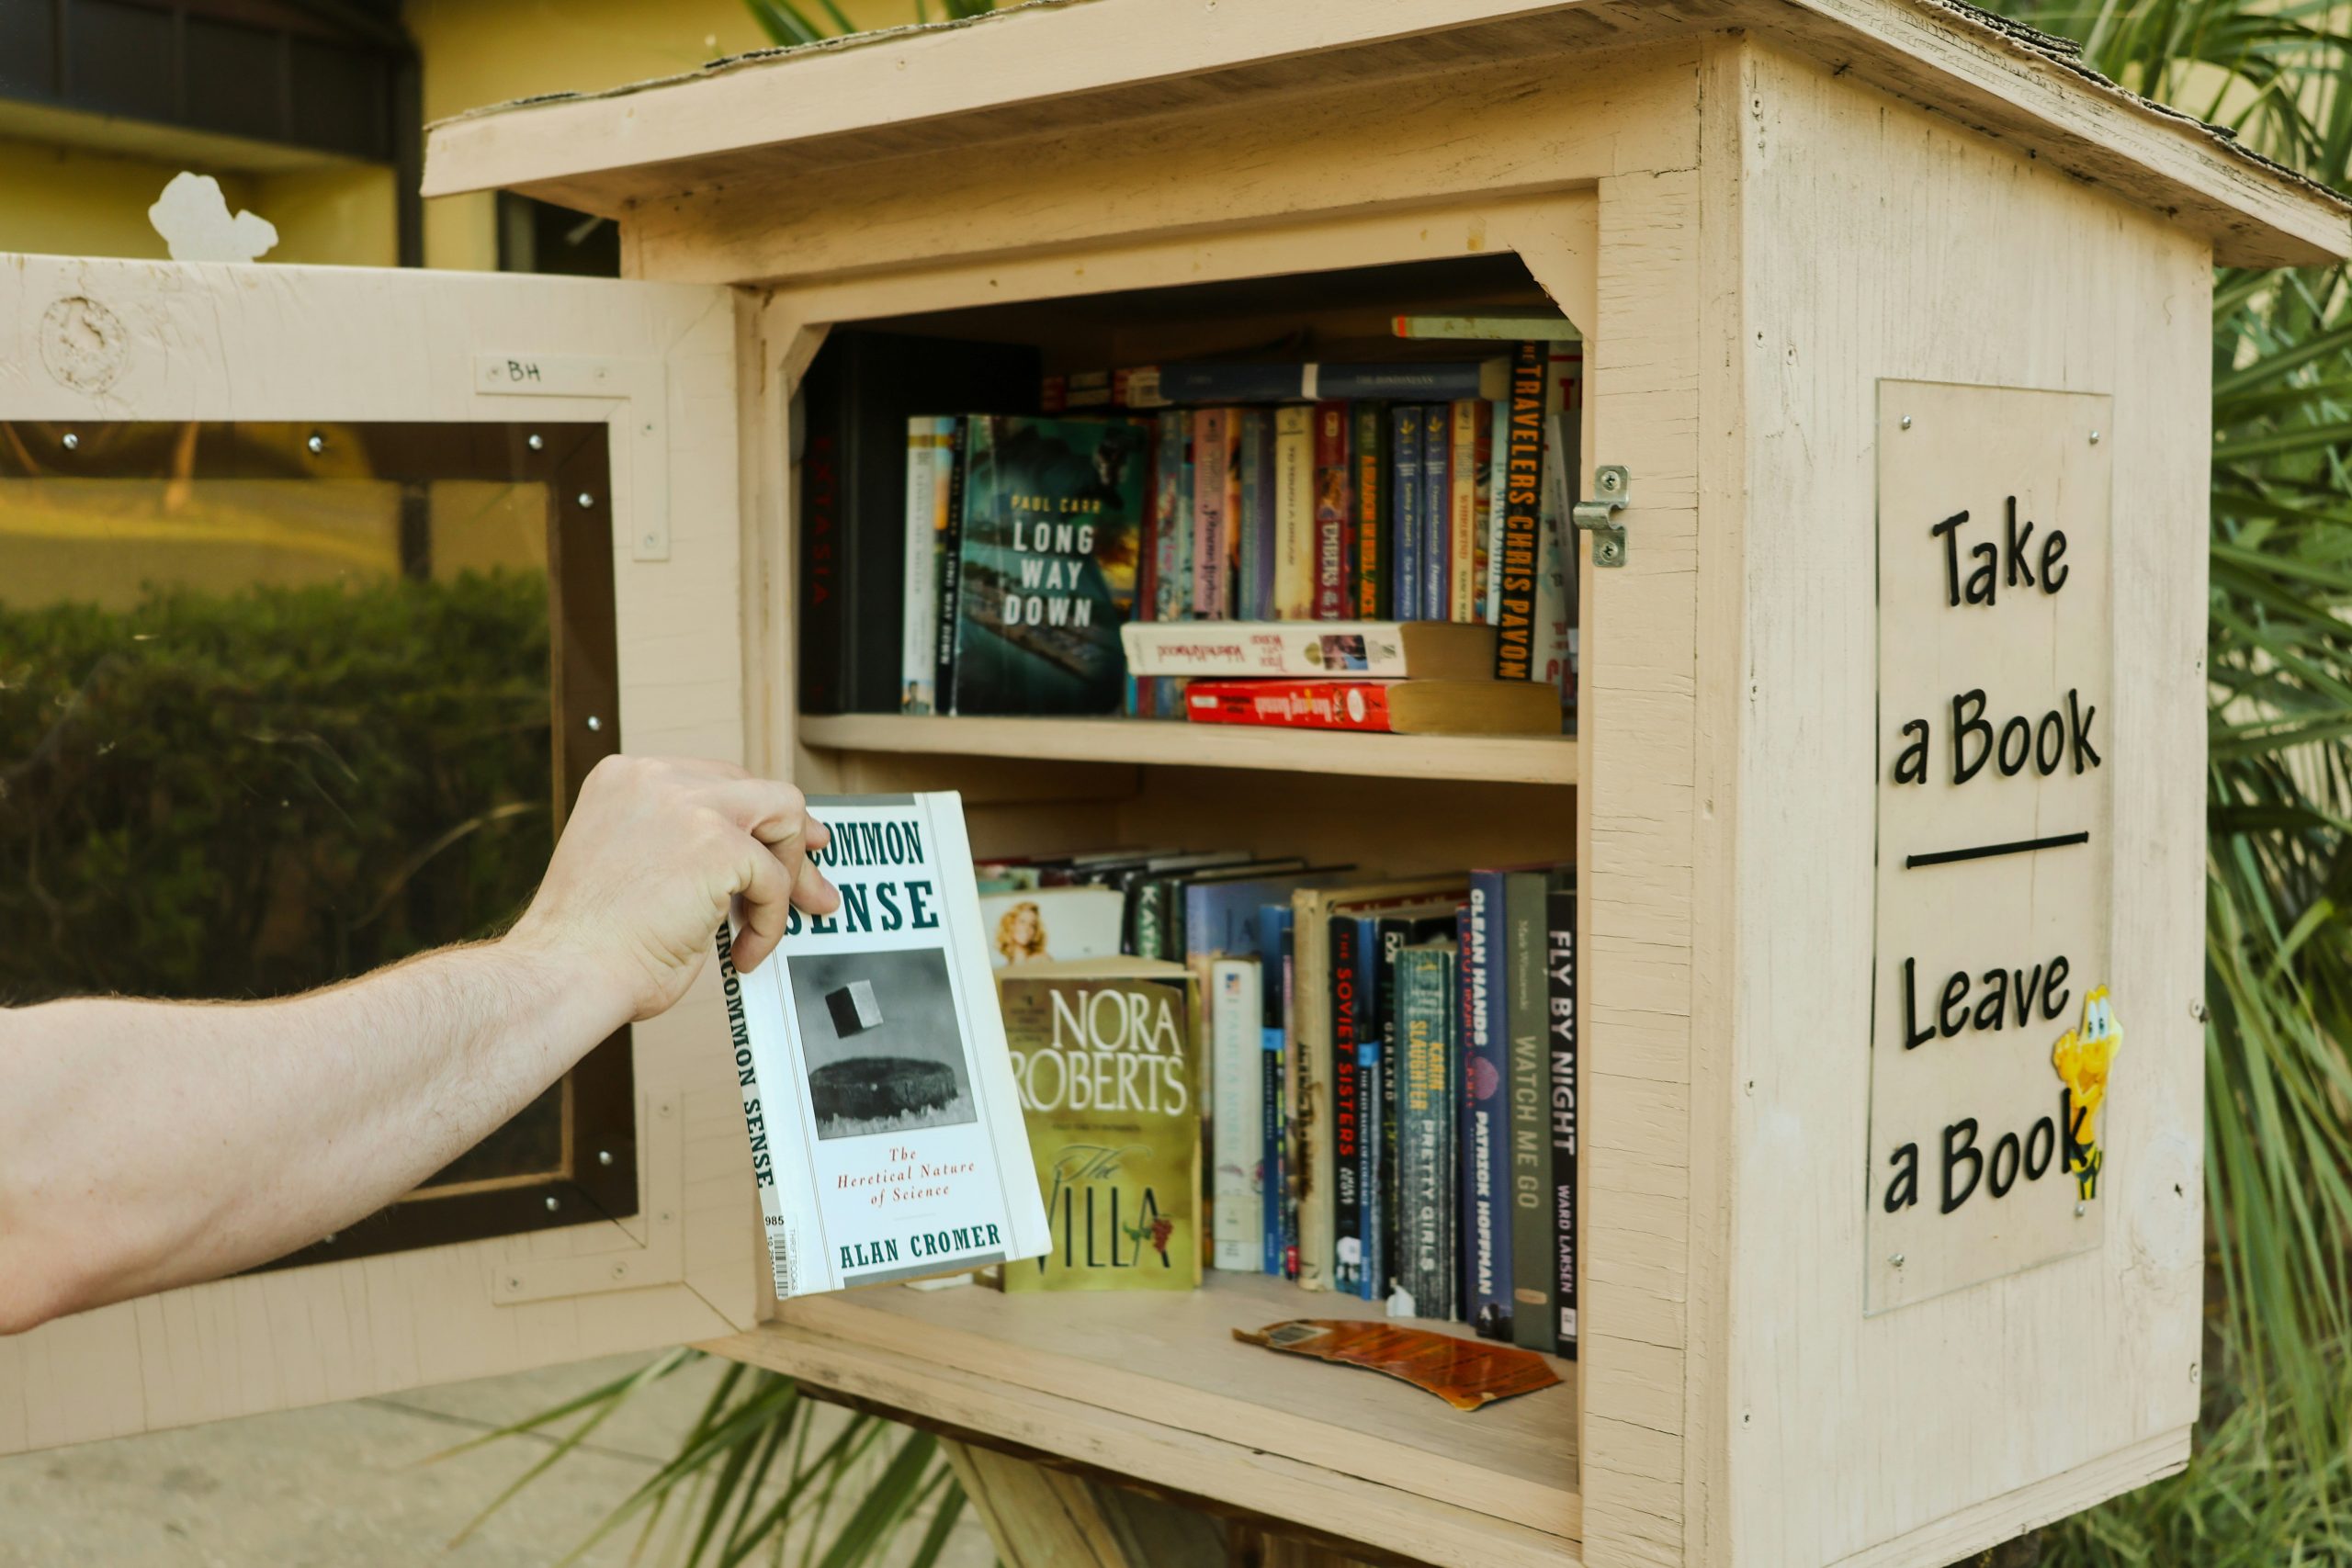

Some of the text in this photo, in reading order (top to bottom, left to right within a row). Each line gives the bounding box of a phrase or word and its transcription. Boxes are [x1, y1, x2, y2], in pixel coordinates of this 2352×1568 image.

[507, 360, 540, 381] BH
[1508, 365, 1542, 505] TRAVELERS
[1012, 495, 1101, 513] PAUL CARR
[1287, 467, 1295, 506] TOUCH
[1012, 521, 1093, 555] LONG
[1322, 522, 1340, 586] EMBERS
[1504, 514, 1534, 592] CHRIS
[1933, 496, 2069, 607] Take
[945, 551, 955, 586] LONG
[1021, 558, 1083, 590] WAY
[944, 592, 953, 619] WAY
[1003, 595, 1091, 626] DOWN
[940, 625, 952, 664] DOWN
[1498, 600, 1530, 679] PAVON
[1894, 687, 2101, 785] a Book
[1518, 919, 1529, 948] Mark
[1549, 930, 1572, 986] FLY
[1049, 988, 1183, 1056] NORA
[1550, 998, 1573, 1041] BY
[1904, 954, 2069, 1050] Leave
[717, 919, 775, 1190] UNCOMMON SENSE
[1225, 1010, 1240, 1084] PAMELA
[1337, 932, 1354, 1156] THE SOVIET SISTERS
[1385, 1022, 1396, 1101] GARLAND
[1409, 1021, 1428, 1111] SLAUGHTER
[1428, 1043, 1444, 1090] KARIN
[1011, 1048, 1187, 1117] ROBERTS
[1471, 889, 1492, 1294] CLEAN HANDS PATRICK HOFFMAN
[1514, 1036, 1538, 1121] WATCH
[1551, 1051, 1574, 1156] NIGHT
[889, 1147, 917, 1163] The
[1054, 1143, 1153, 1182] The
[1361, 1145, 1368, 1157] OF
[1517, 1130, 1538, 1167] ME
[1884, 1088, 2088, 1214] a Book
[838, 1161, 976, 1189] Heretical Nature
[870, 1183, 949, 1207] of Science
[1419, 1120, 1435, 1271] PRETTY GIRLS
[1517, 1176, 1539, 1209] GO
[765, 1216, 784, 1225] 985
[1557, 1185, 1571, 1229] WARD
[788, 1229, 797, 1291] THRIFTBOOKS
[840, 1224, 1001, 1269] ALAN CROMER
[1559, 1235, 1572, 1292] LARSEN
